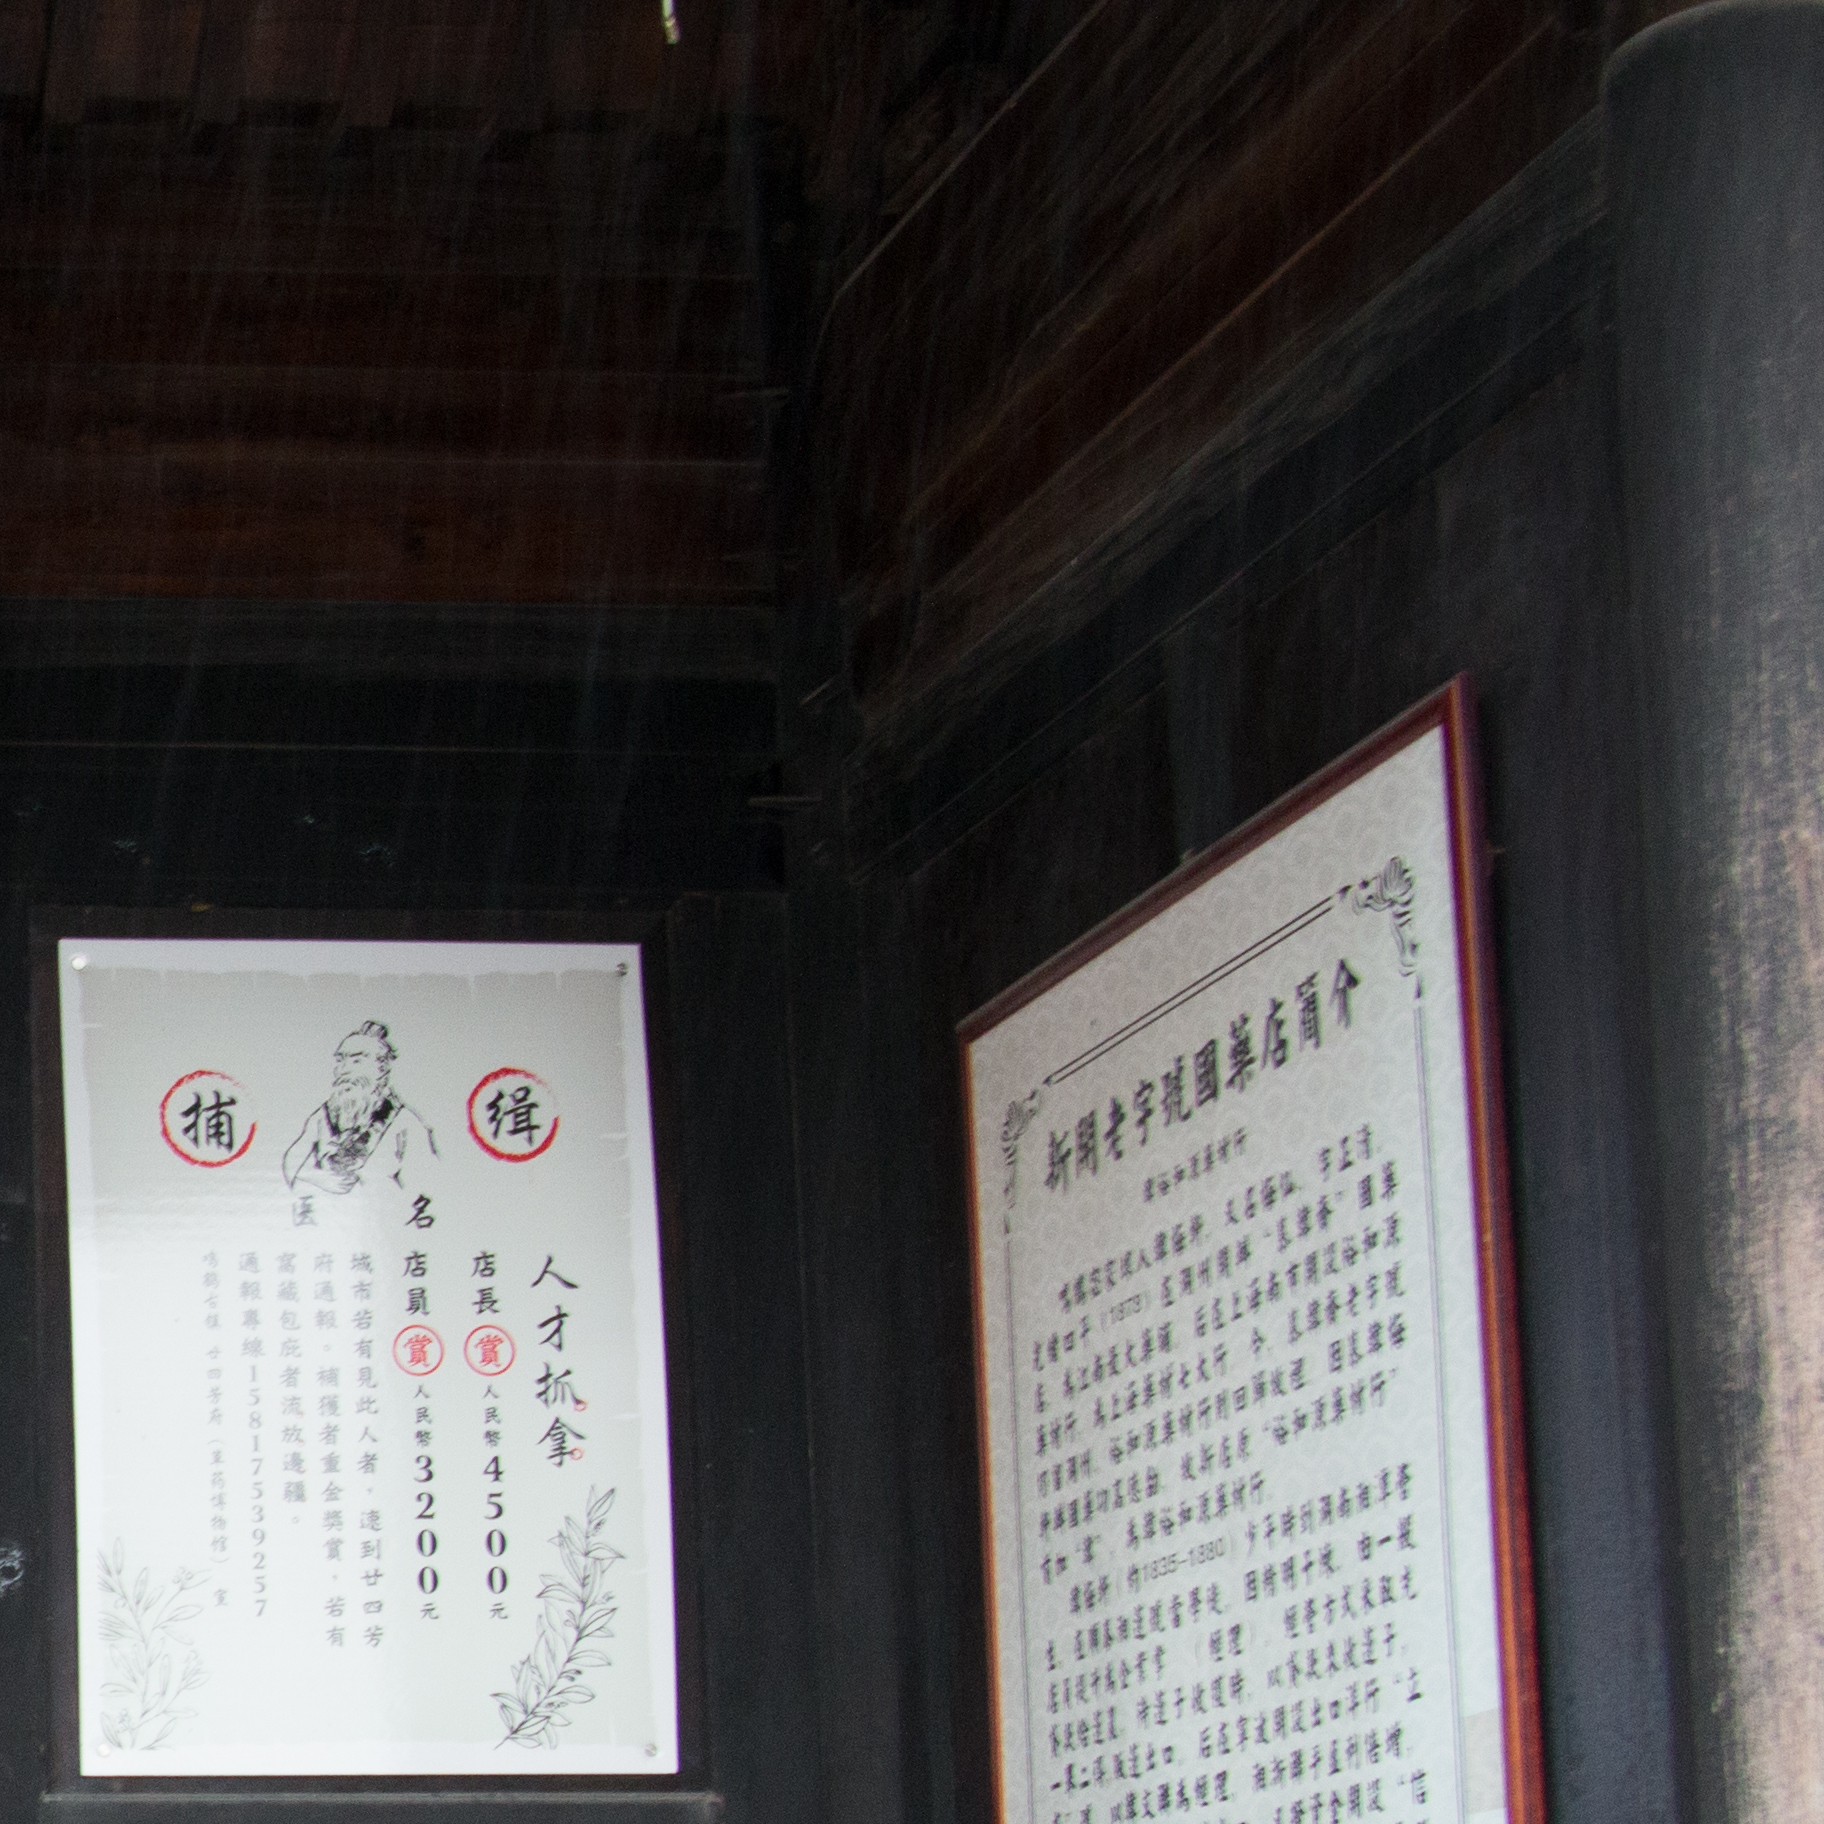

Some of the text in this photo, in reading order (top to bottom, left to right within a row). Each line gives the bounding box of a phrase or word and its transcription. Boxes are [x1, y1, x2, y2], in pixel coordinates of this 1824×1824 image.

[1043, 958, 1361, 1191] 新開老字號國藥店簡介
[181, 1085, 541, 1152] 缉 捕
[291, 1194, 434, 1230] 名 医
[402, 1250, 431, 1316] 店員
[471, 1250, 500, 1315] 店長
[402, 1333, 433, 1367] 賞
[473, 1333, 504, 1367] 賞
[531, 1253, 586, 1467] 人才抓拿
